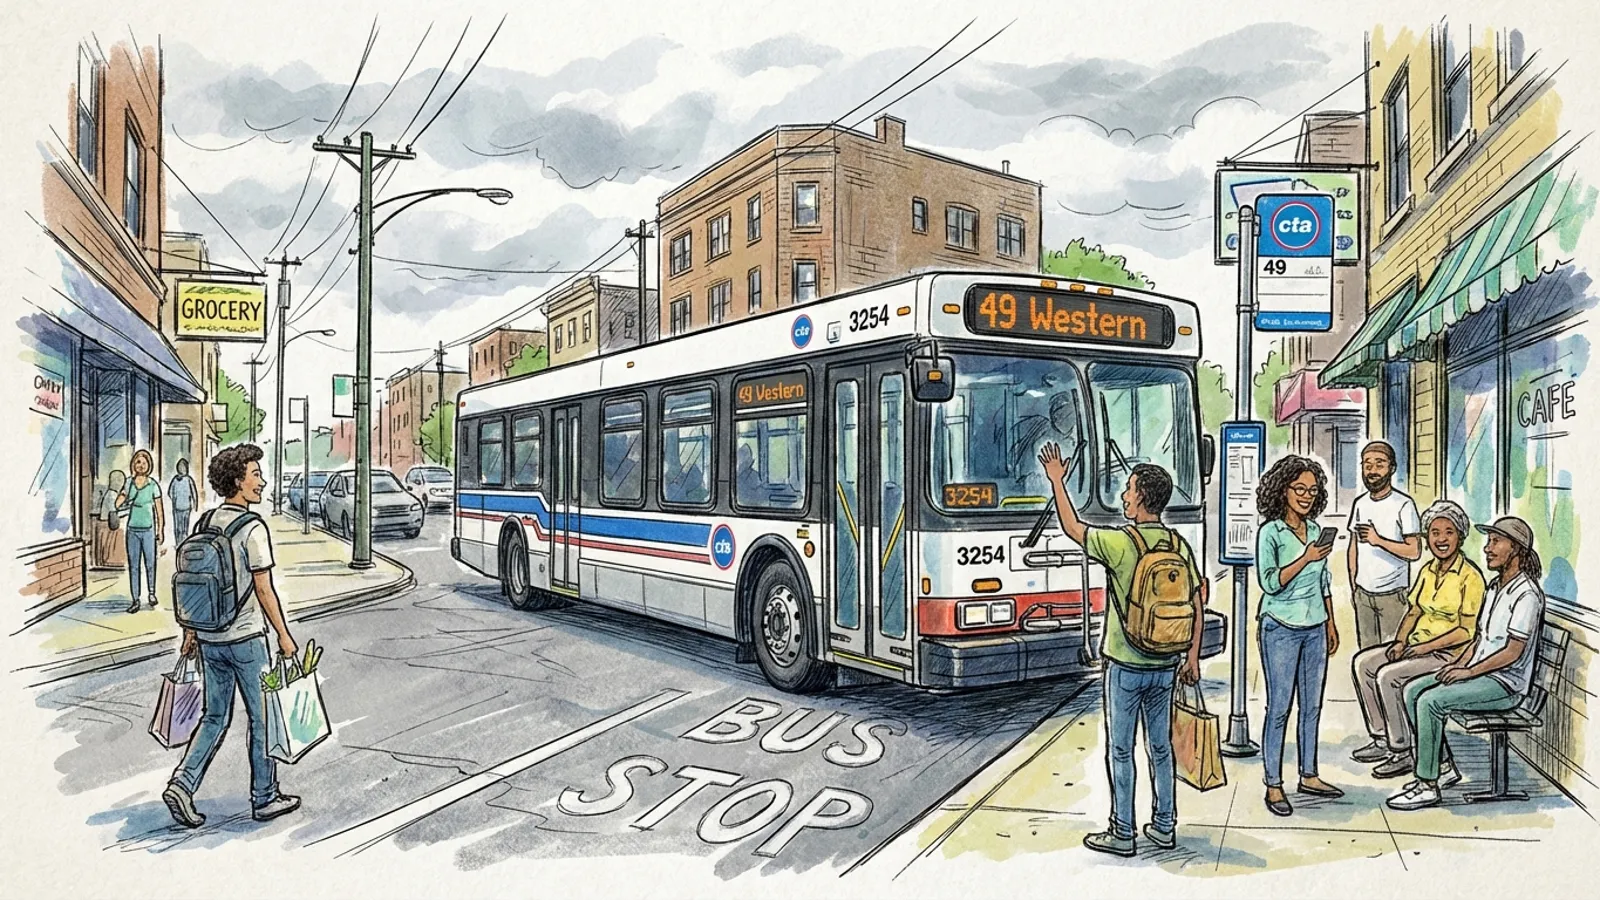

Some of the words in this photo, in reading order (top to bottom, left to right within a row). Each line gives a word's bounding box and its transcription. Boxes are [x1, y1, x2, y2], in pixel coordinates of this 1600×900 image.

[1278, 217, 1312, 233] cta
[1263, 259, 1287, 275] 49
[182, 298, 262, 321] GROCERY
[849, 303, 890, 332] 3254
[979, 292, 1017, 330] 49
[1029, 296, 1147, 341] Western
[1517, 380, 1576, 428] CAFE
[945, 486, 992, 506] 3254
[957, 545, 1005, 566] 3254
[678, 697, 908, 769] BUS
[556, 754, 875, 859] STOP
